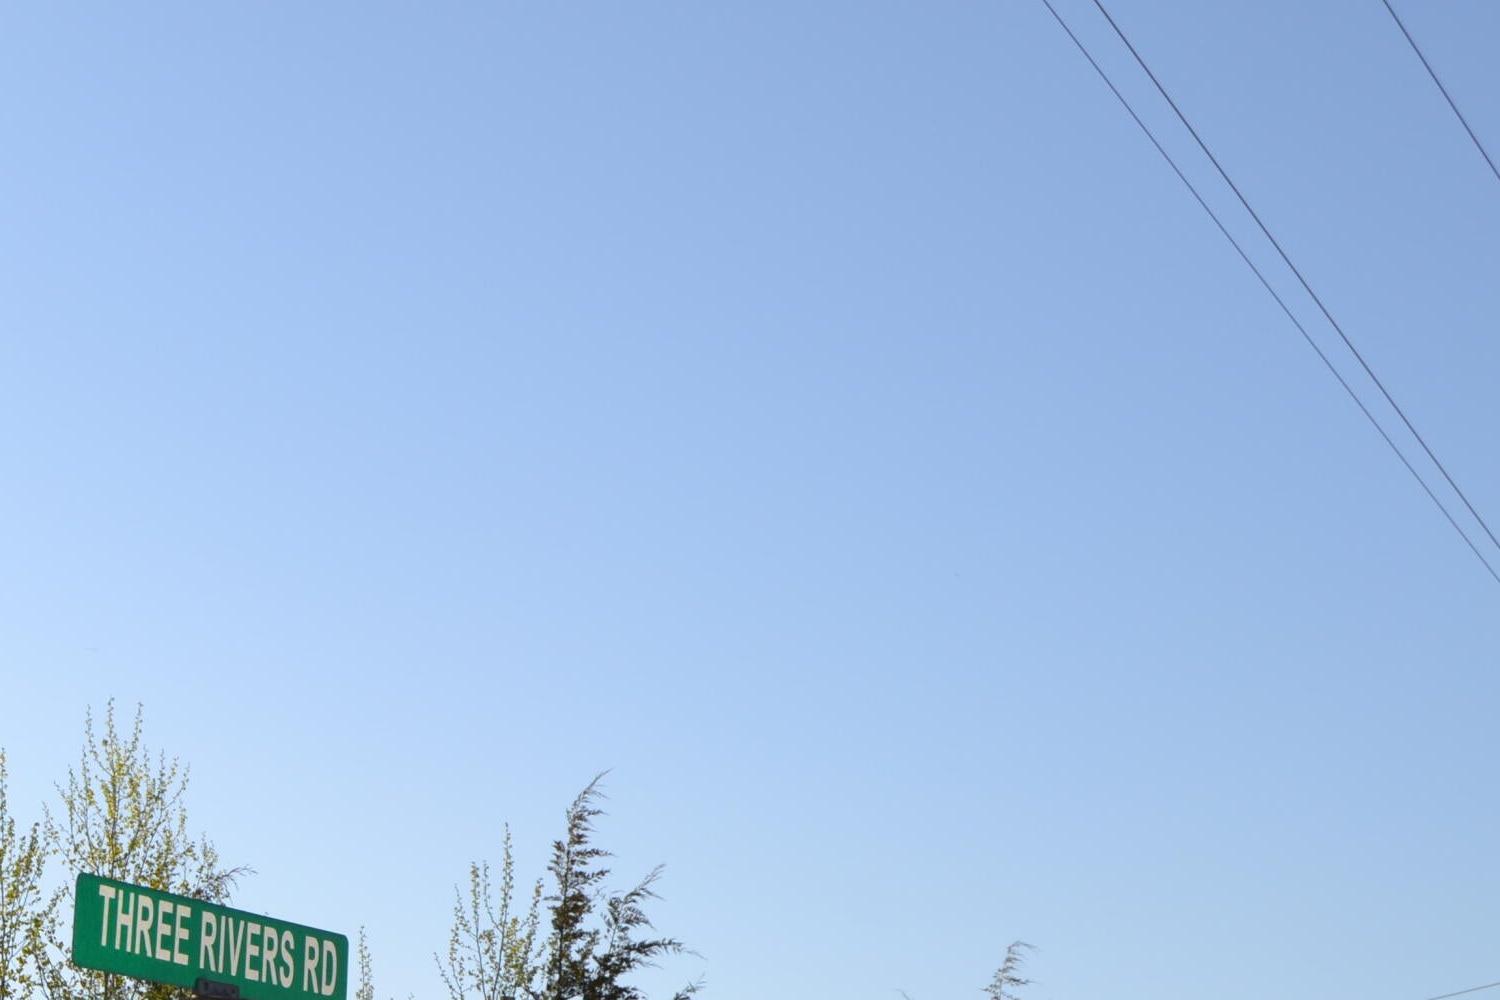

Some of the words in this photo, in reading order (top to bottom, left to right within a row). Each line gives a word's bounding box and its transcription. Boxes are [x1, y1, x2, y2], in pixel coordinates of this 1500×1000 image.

[99, 884, 192, 966] THREE
[200, 910, 295, 988] RIVERS
[303, 936, 337, 996] RD
